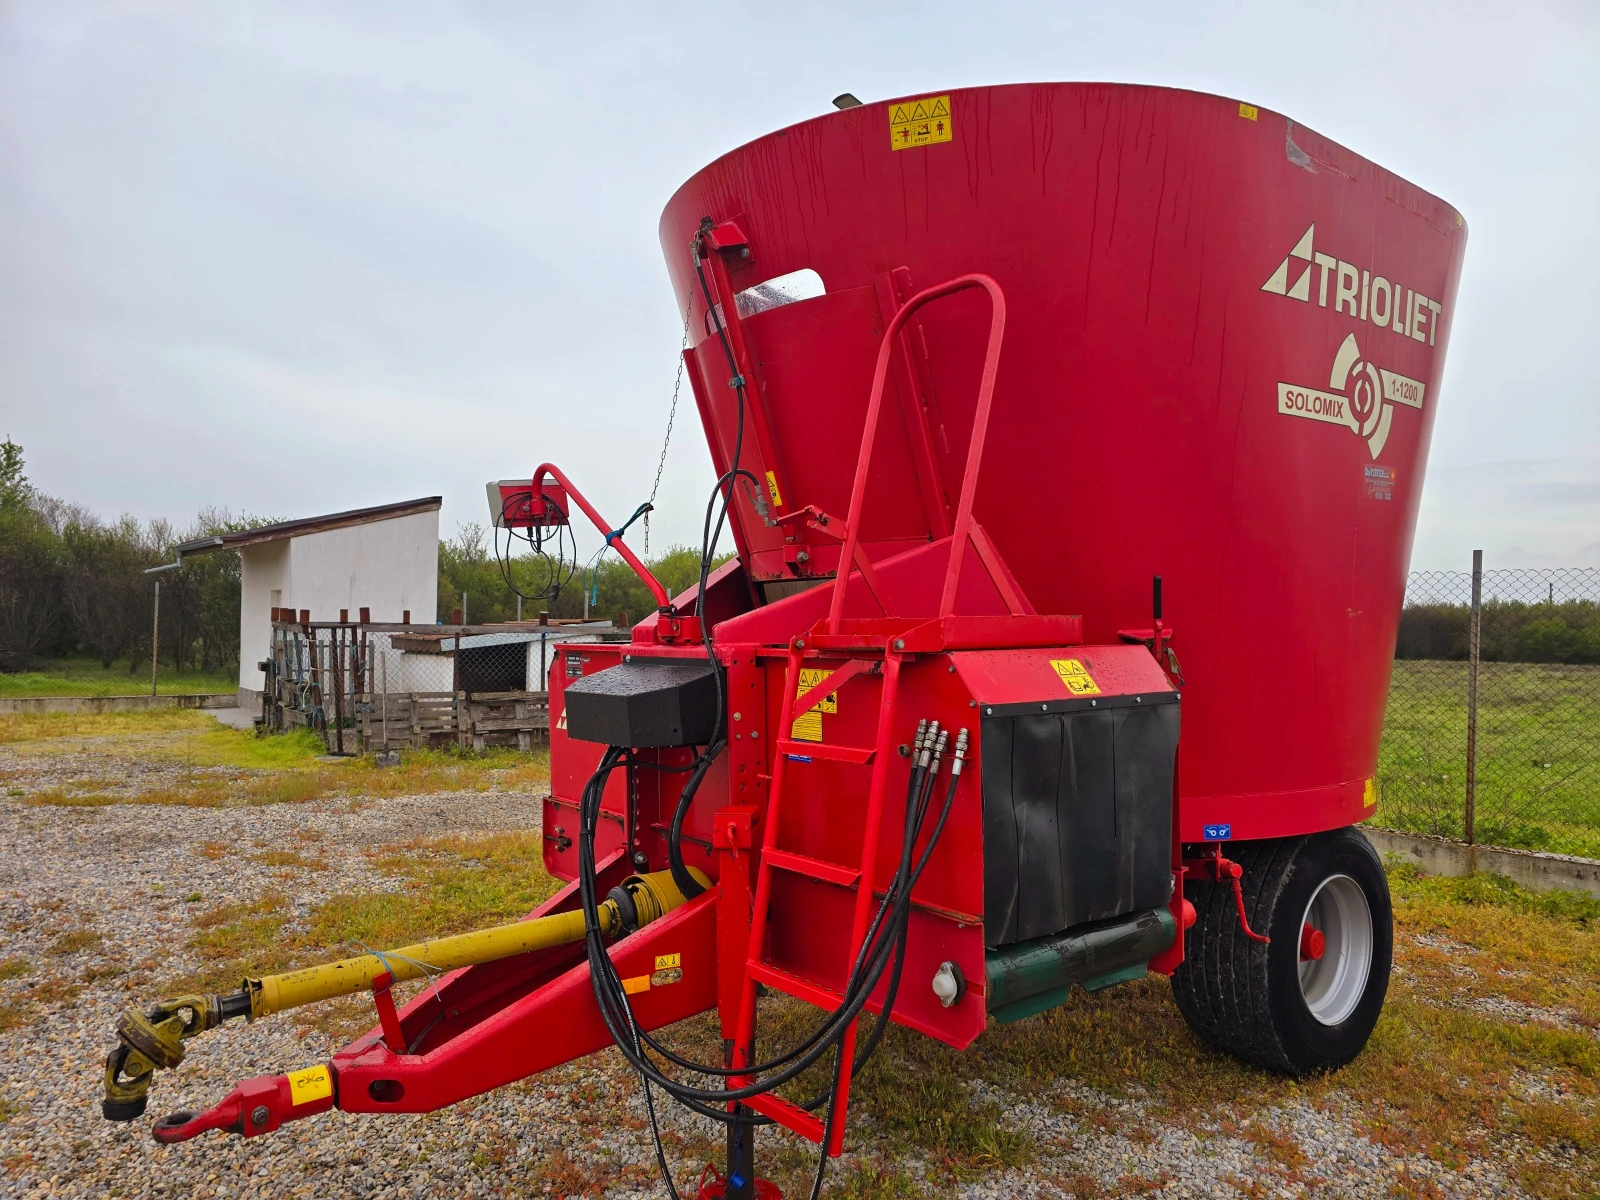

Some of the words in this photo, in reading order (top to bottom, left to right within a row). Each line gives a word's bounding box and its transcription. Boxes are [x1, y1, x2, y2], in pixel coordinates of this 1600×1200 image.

[1314, 250, 1442, 347] TRIOLIET
[1285, 390, 1344, 419] SOLOMIX
[1391, 379, 1418, 402] 1-1200
